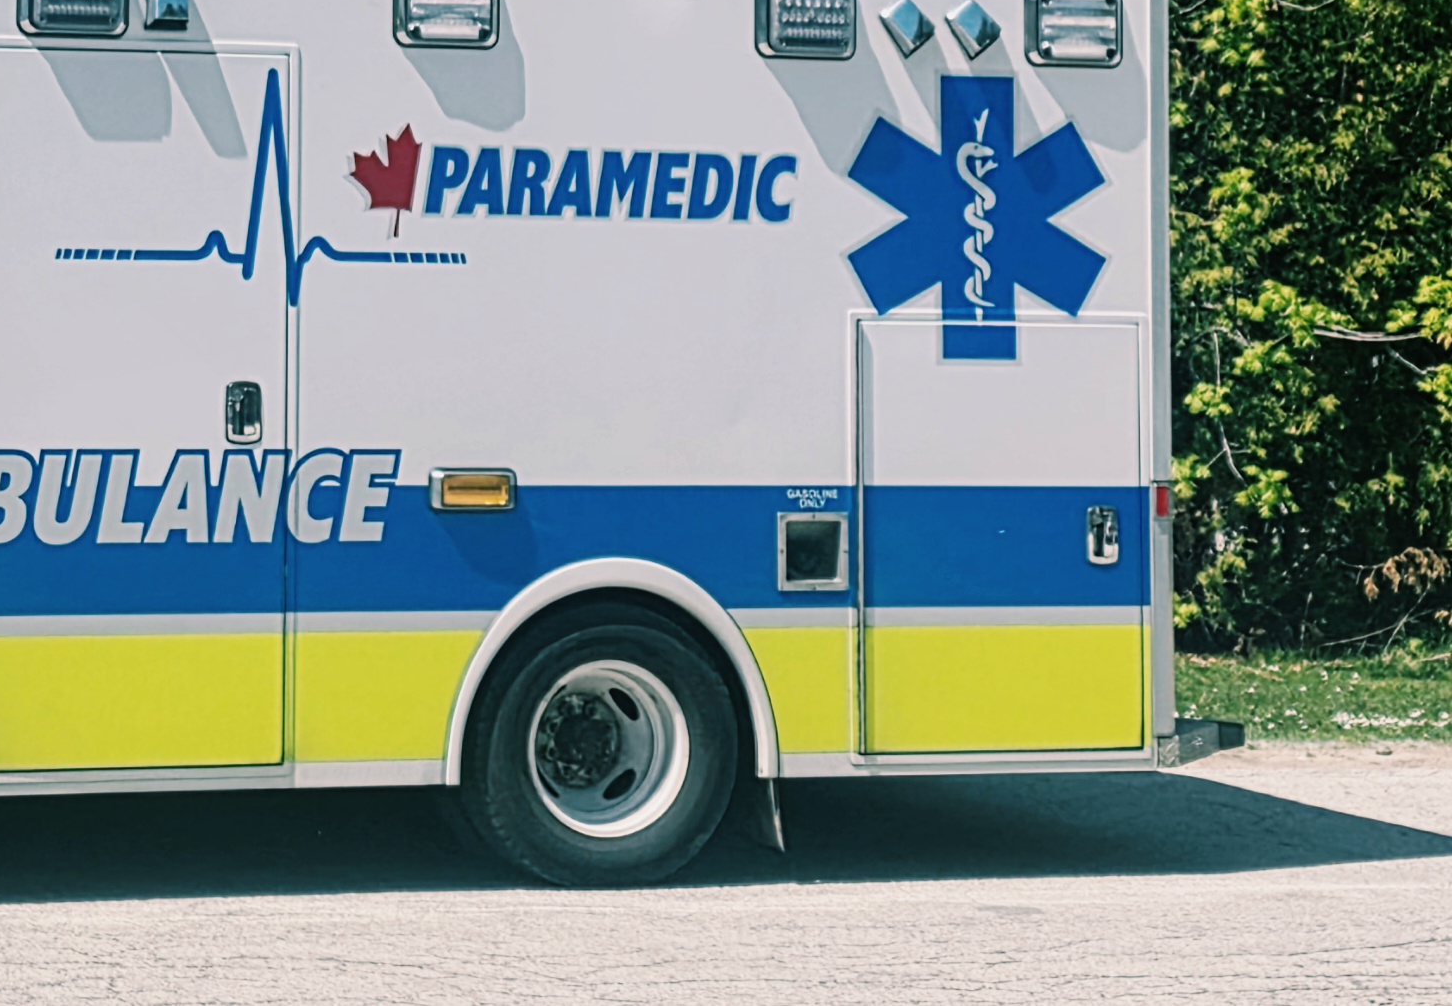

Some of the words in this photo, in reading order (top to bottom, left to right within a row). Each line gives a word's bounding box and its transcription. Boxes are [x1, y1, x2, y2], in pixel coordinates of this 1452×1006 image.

[422, 144, 799, 225] PARAMEDIC
[786, 487, 838, 499] GASOLINE
[799, 498, 826, 509] ONLY
